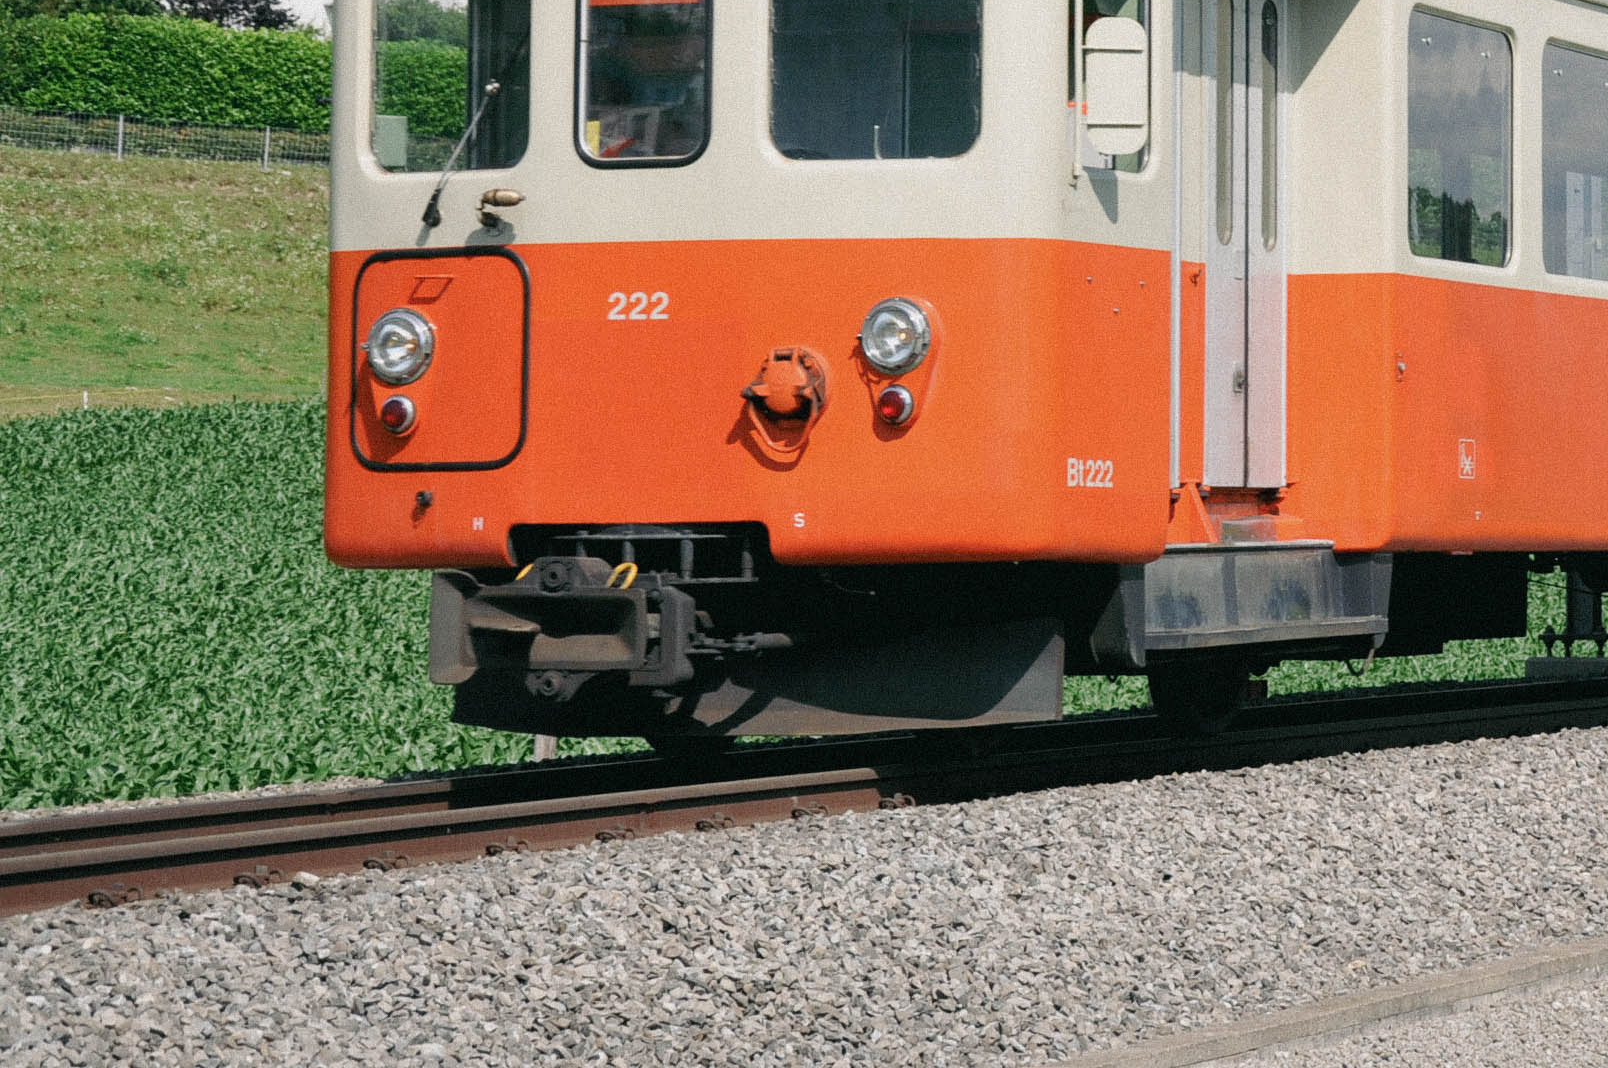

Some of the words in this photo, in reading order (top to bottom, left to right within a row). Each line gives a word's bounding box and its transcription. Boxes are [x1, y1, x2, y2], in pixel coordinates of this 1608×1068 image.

[607, 291, 670, 320] 222
[472, 516, 484, 531] H
[793, 512, 805, 528] S
